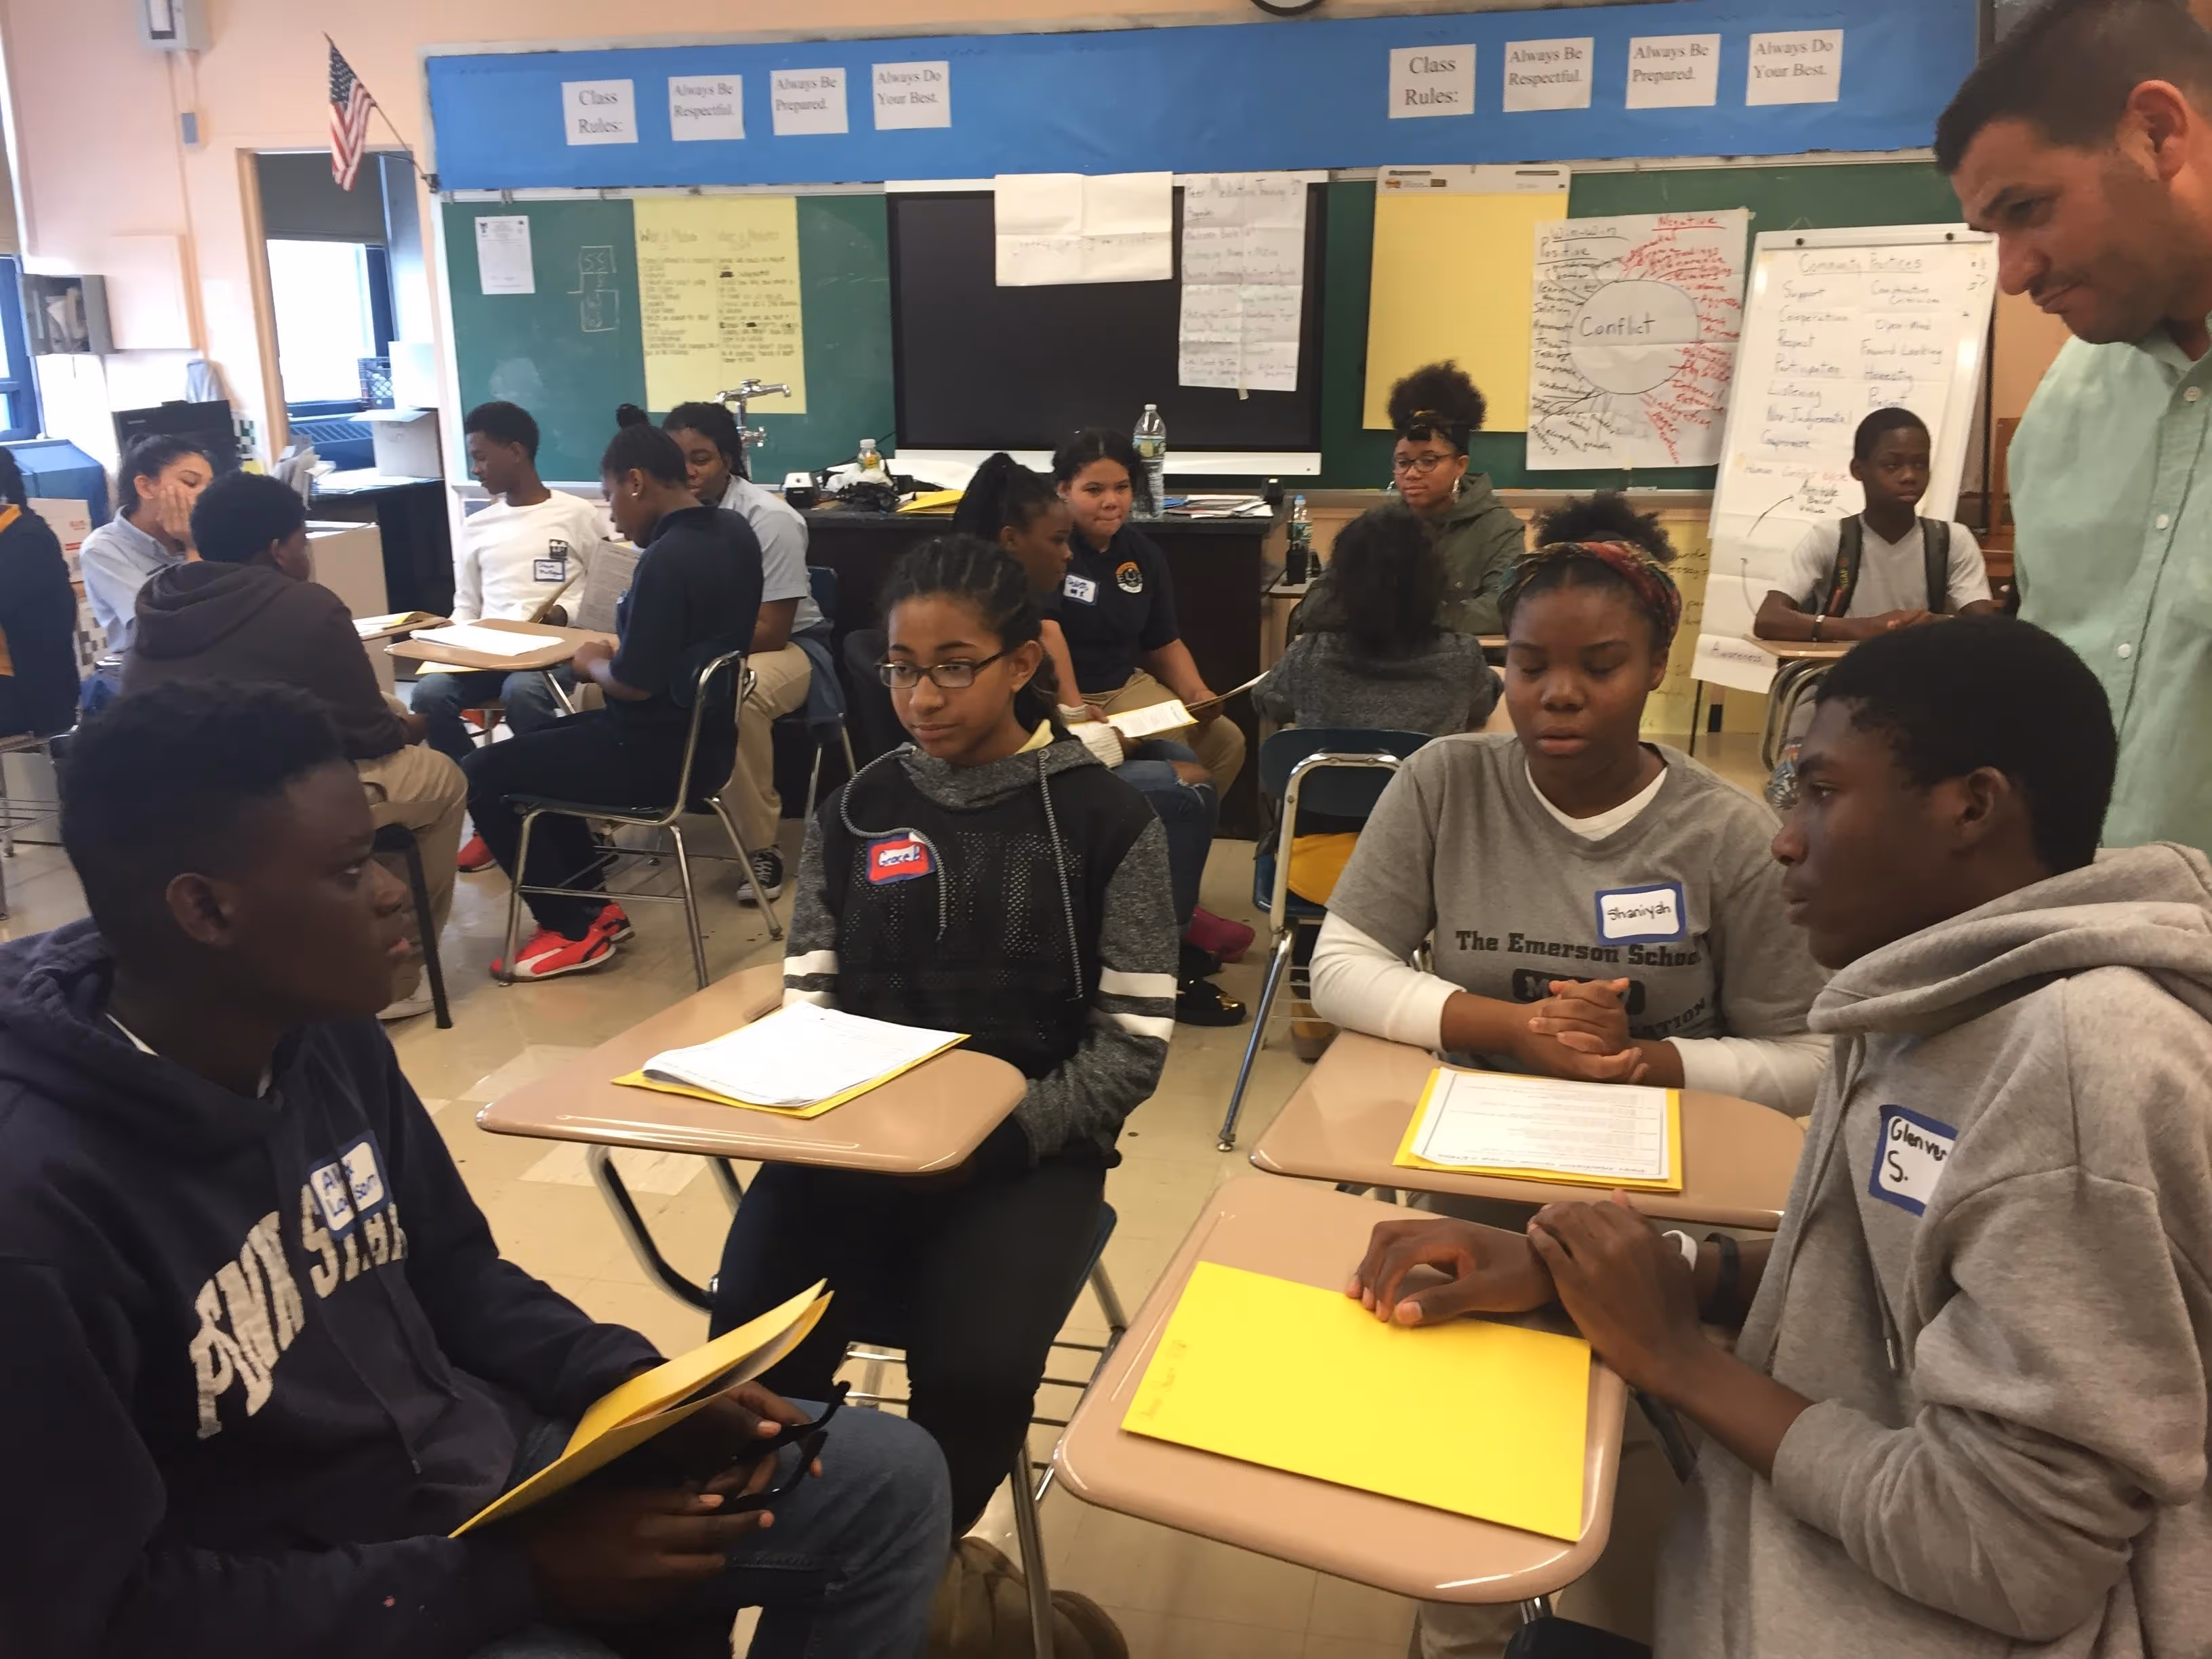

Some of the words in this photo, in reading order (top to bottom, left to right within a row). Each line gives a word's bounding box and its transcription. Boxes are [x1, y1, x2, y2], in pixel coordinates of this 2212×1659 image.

[1509, 47, 1559, 64] Always
[1563, 45, 1583, 61] Be
[1634, 44, 1685, 62] Always
[1689, 43, 1708, 58] Be
[1755, 41, 1807, 58] Always
[1811, 38, 1834, 54] Do
[1409, 56, 1456, 75] Class
[1753, 62, 1788, 79] Your
[1793, 61, 1827, 78] Best.
[777, 77, 816, 92] Always
[820, 76, 838, 88] Be
[877, 70, 919, 87] Always
[922, 69, 943, 83] Do
[1509, 68, 1581, 87] Respectful.
[1633, 66, 1696, 85] Prepared.
[578, 89, 618, 107] Class
[674, 84, 714, 99] Always
[717, 83, 734, 96] Be
[877, 91, 906, 106] Your
[910, 91, 939, 105] Best.
[1405, 86, 1459, 106] Rules:
[674, 102, 735, 119] Respectful.
[777, 98, 828, 114] Prepared.
[577, 117, 623, 134] Rules:
[1607, 900, 1671, 922] Shaniyah
[1455, 929, 1499, 951] The
[1507, 932, 1620, 964] Emerson
[1628, 943, 1702, 967] Schoo
